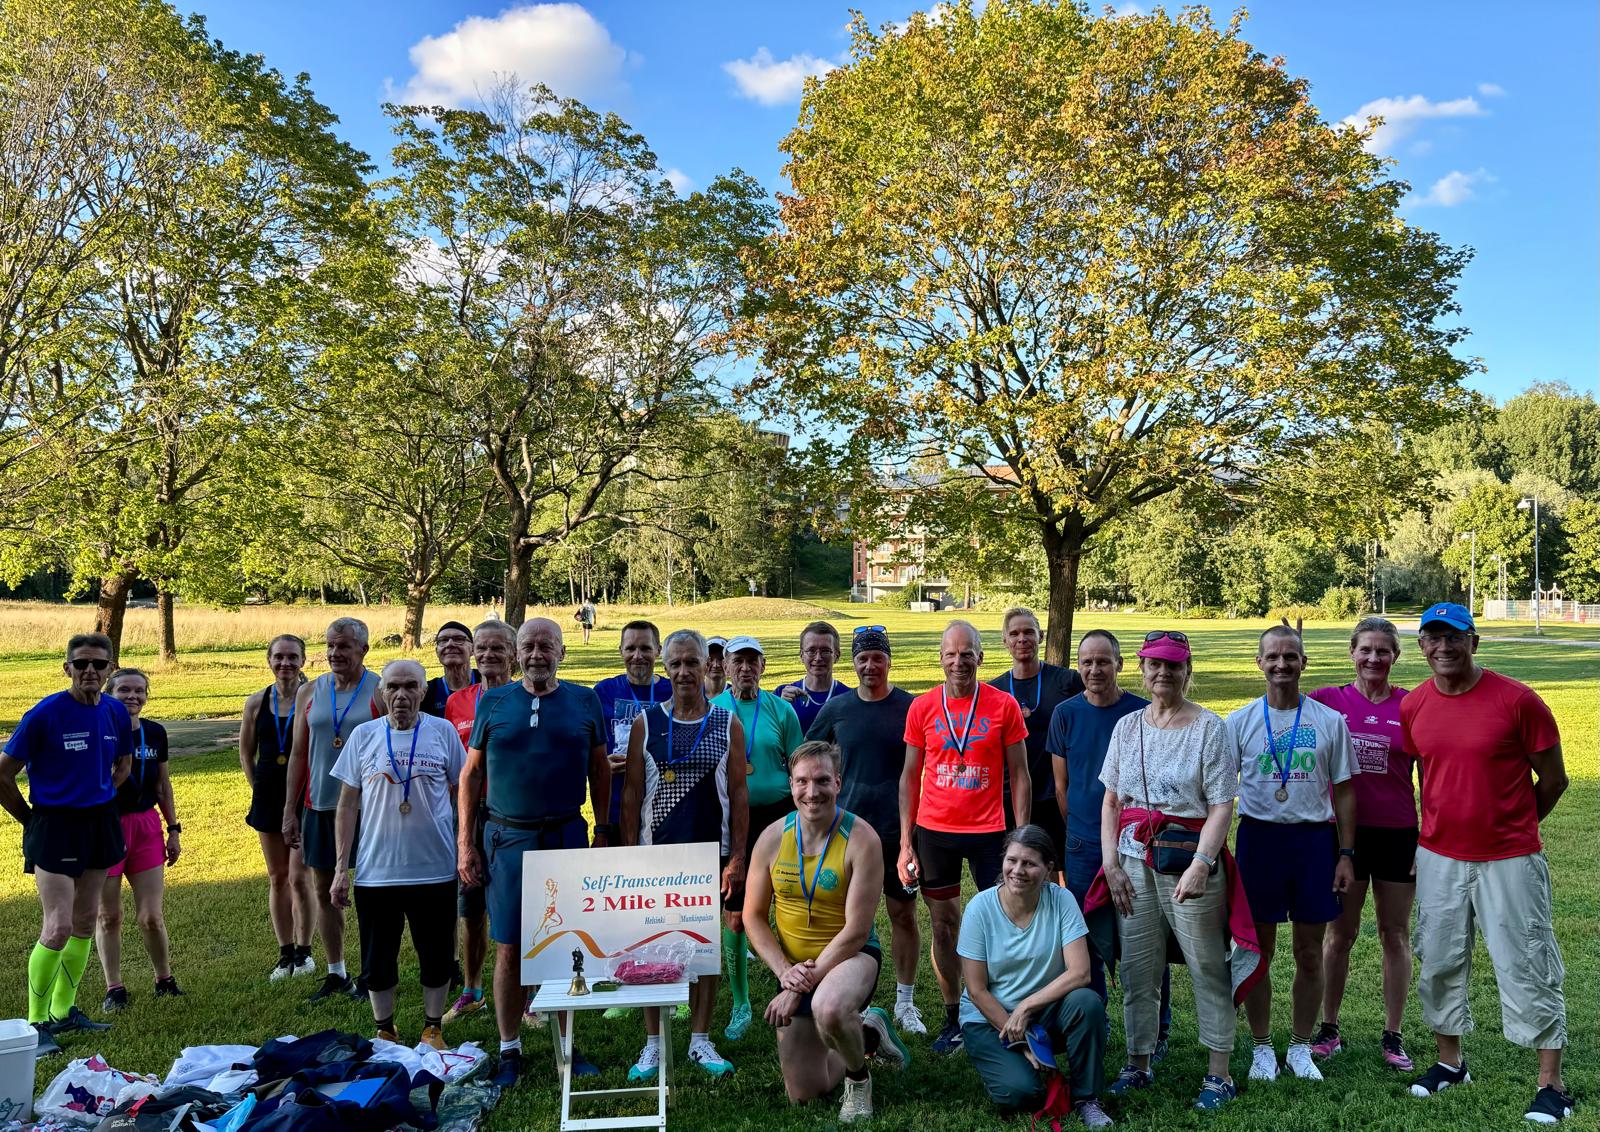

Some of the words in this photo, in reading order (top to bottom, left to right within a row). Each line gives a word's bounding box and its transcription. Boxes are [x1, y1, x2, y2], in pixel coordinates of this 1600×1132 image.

[396, 759, 417, 767] Mie
[582, 872, 713, 893] Self-Transcendence
[582, 897, 596, 912] 2
[603, 894, 657, 911] Mile
[664, 893, 712, 908] Run
[644, 916, 666, 925] Helsinki
